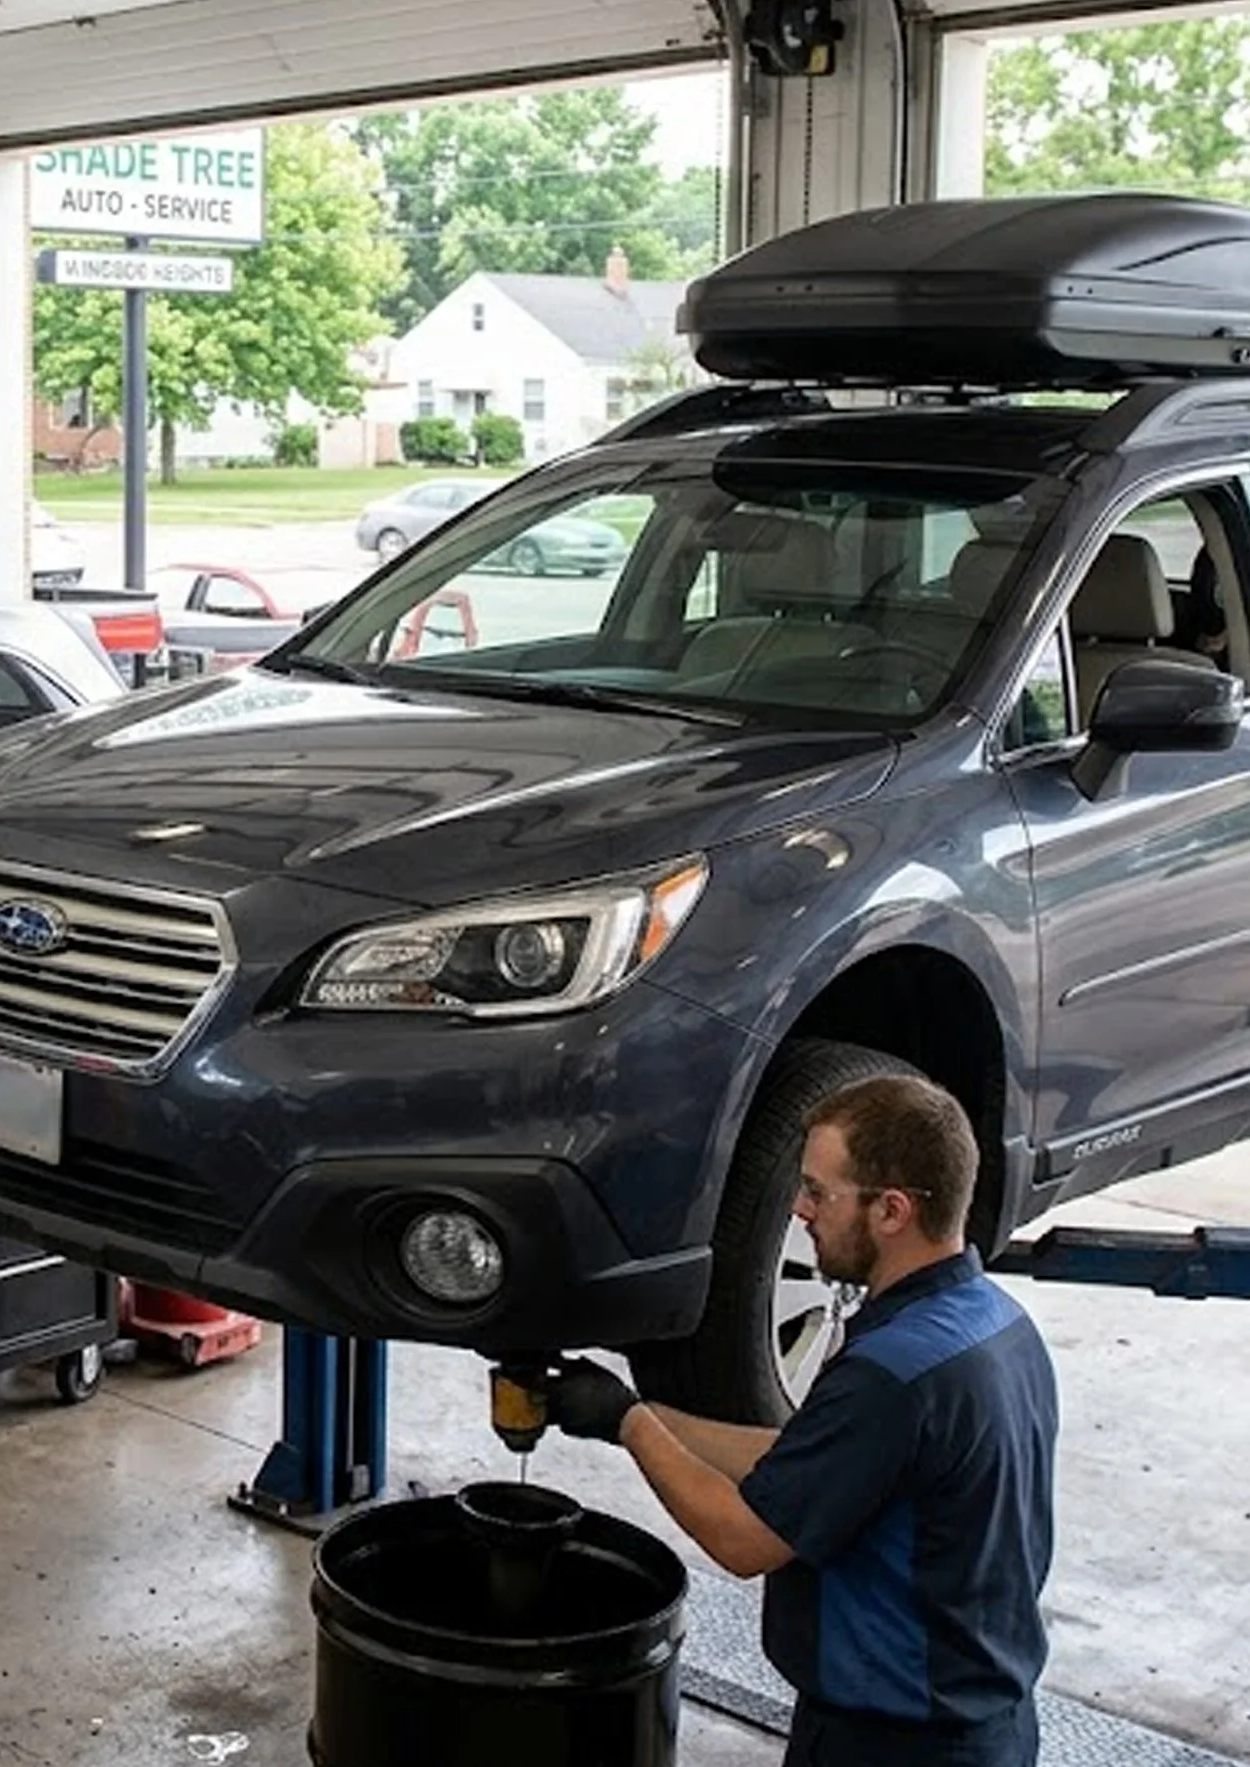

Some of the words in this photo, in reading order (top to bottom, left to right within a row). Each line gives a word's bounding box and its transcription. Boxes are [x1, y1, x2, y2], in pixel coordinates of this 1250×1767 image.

[35, 144, 158, 180] SHADE
[171, 146, 254, 188] TREE
[61, 188, 123, 215] AUTO
[144, 193, 232, 224] SERVICE
